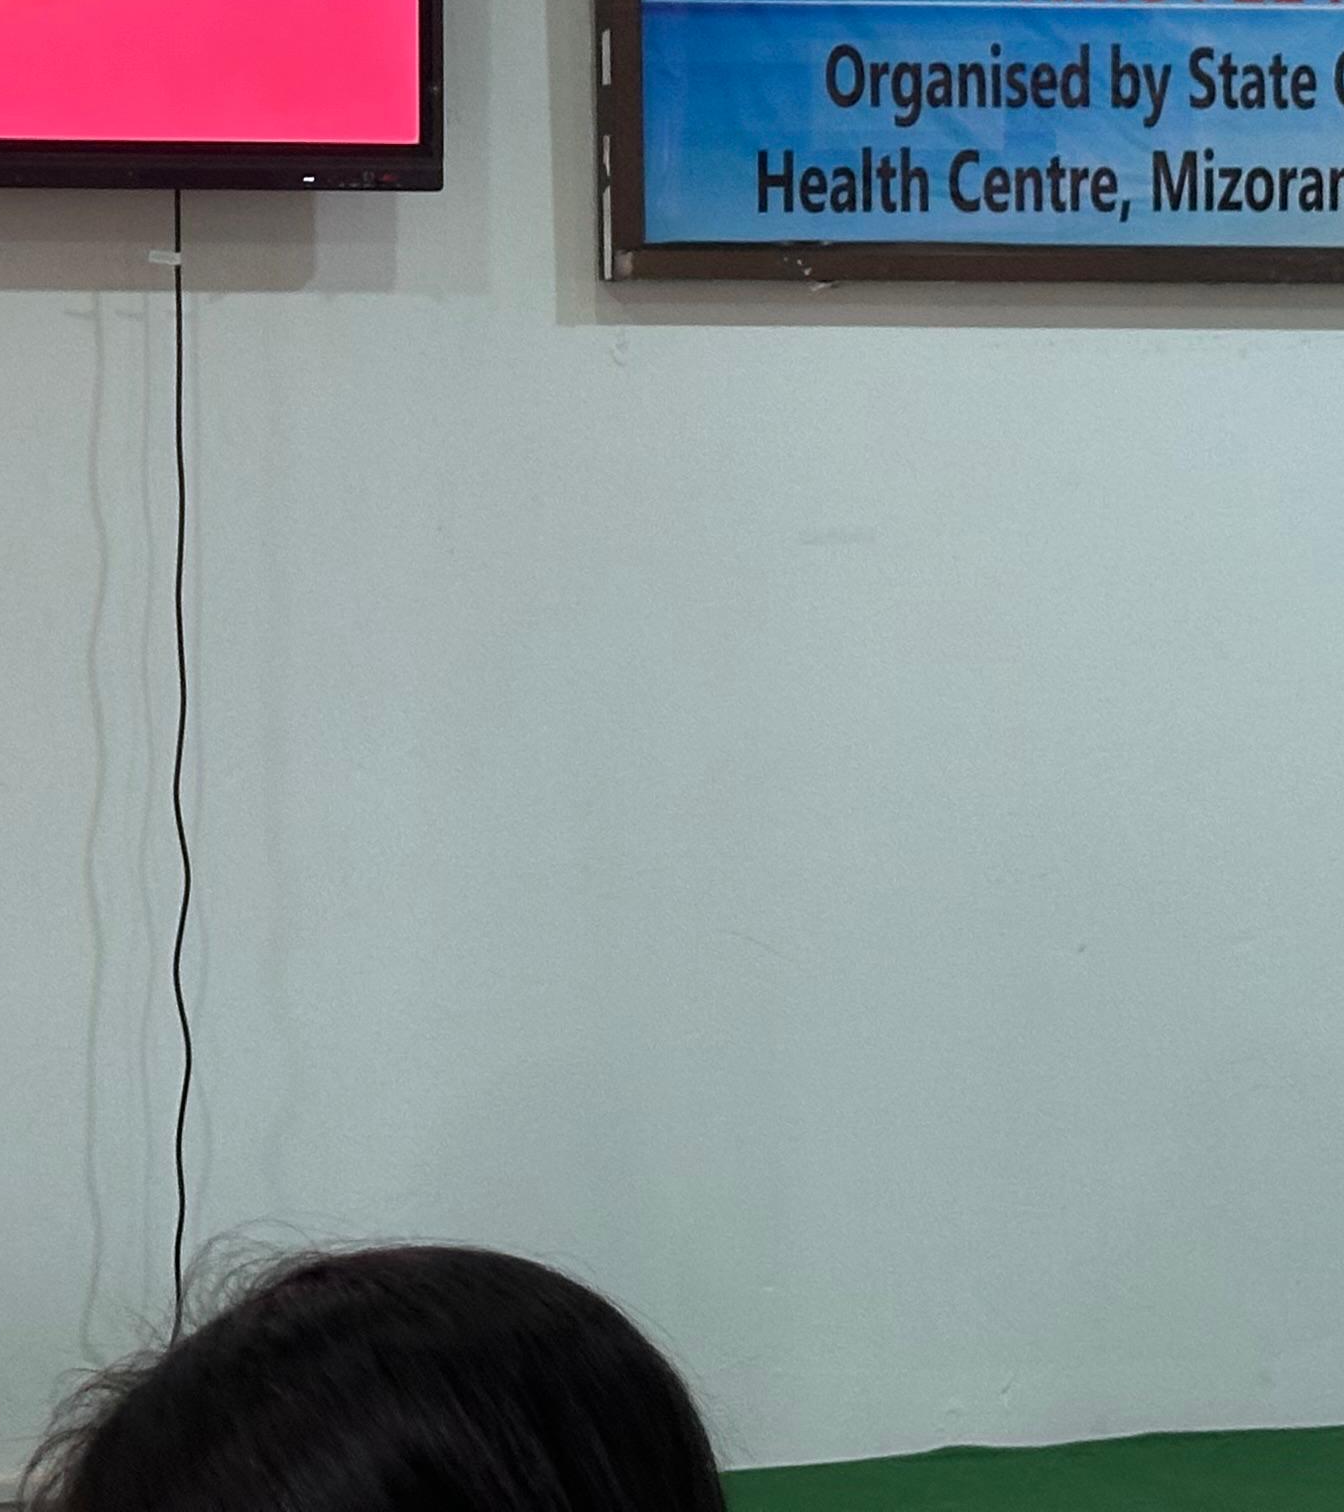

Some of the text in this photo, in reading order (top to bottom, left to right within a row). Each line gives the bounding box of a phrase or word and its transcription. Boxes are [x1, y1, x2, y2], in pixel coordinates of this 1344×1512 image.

[824, 43, 1091, 128] Organised
[1110, 43, 1173, 128] by
[1188, 46, 1318, 110] State
[757, 145, 930, 214] Health
[948, 148, 1132, 222] Centre,
